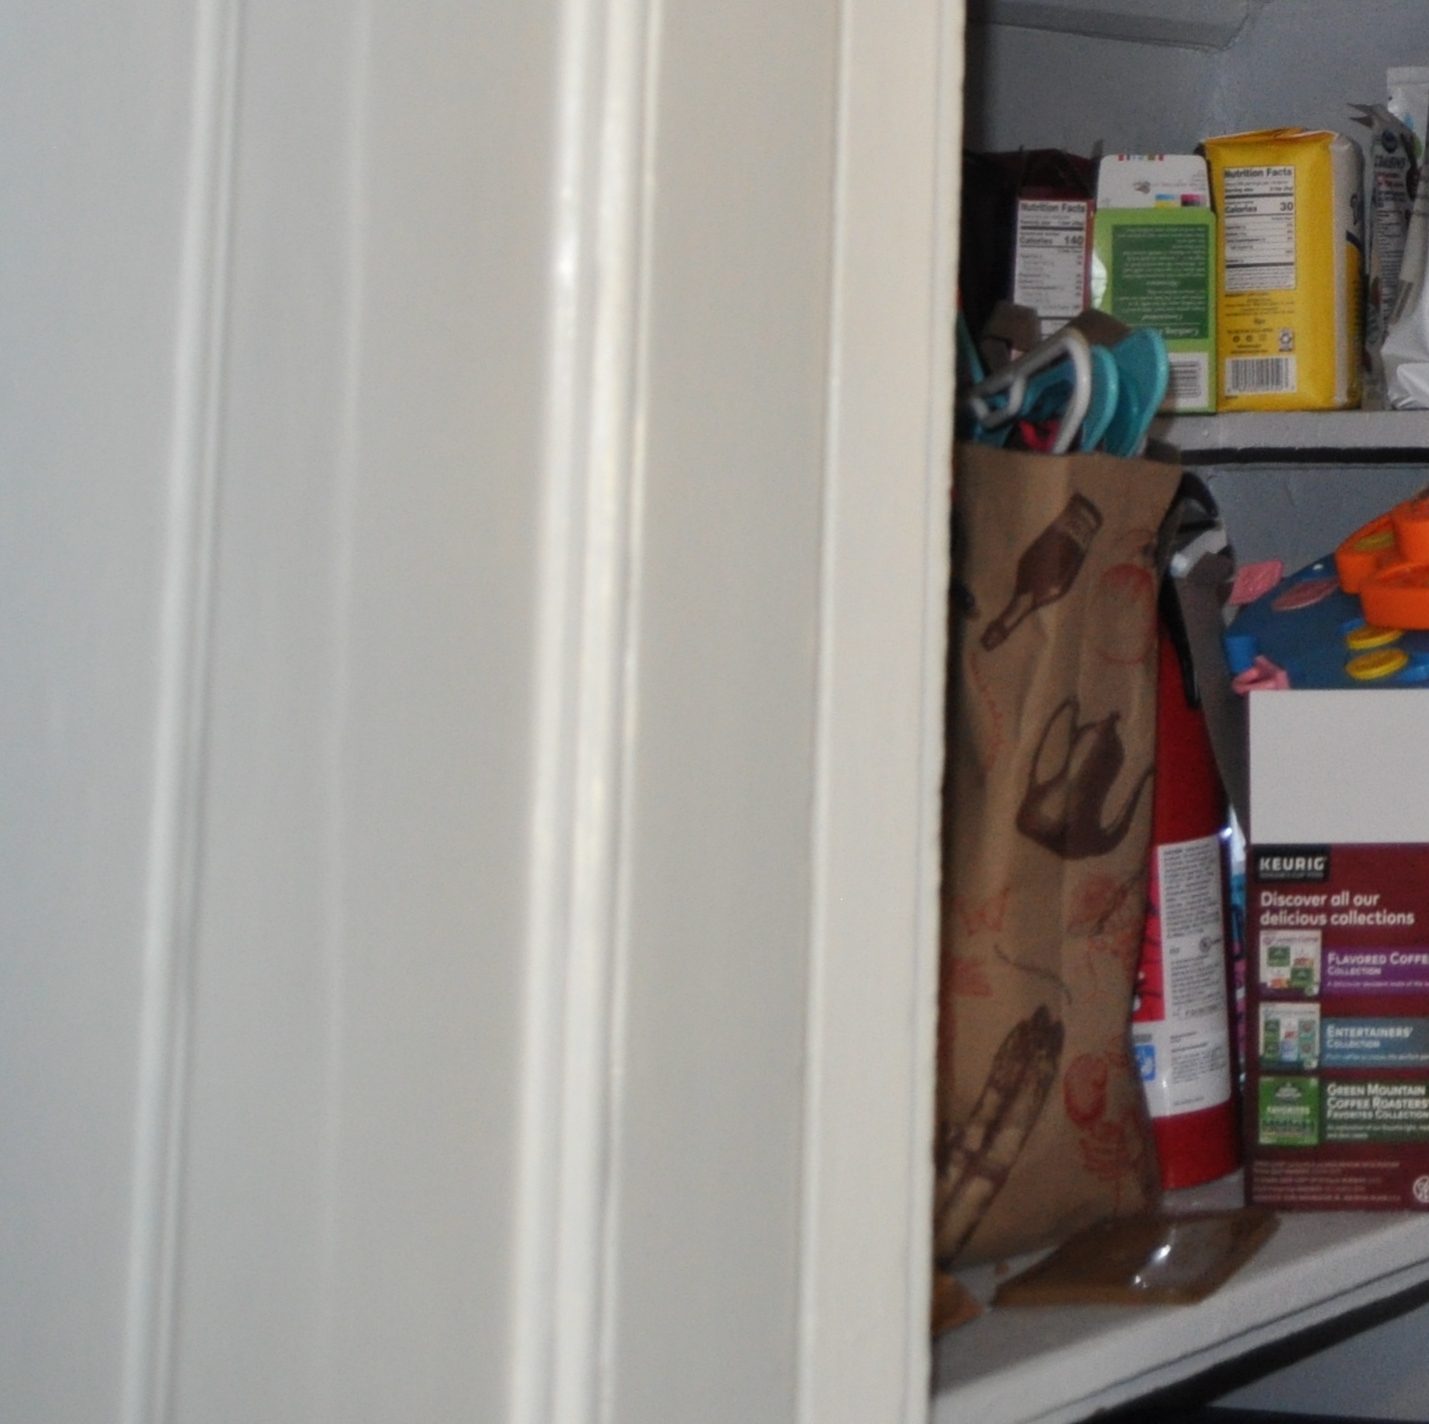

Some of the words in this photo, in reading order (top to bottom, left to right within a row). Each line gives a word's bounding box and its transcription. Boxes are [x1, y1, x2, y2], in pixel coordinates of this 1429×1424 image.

[1224, 169, 1264, 178] Nutrition
[1266, 167, 1292, 177] Facts
[1020, 202, 1059, 213] Nutrition
[1060, 202, 1086, 213] Facts
[1225, 204, 1258, 214] Calories
[1279, 201, 1294, 212] 30
[1019, 236, 1053, 245] Calories
[1064, 235, 1084, 246] 140
[1258, 856, 1328, 874] KEURIG
[1260, 890, 1329, 908] Discover
[1330, 890, 1351, 907] all
[1352, 893, 1381, 907] our
[1260, 909, 1328, 927] delicious
[1329, 908, 1416, 926] collections
[1327, 952, 1387, 966] FLAVORED
[1327, 966, 1383, 977] COLLECTION
[1326, 1040, 1381, 1052] COLLECTION
[1327, 1083, 1365, 1097] GREEN
[1366, 1084, 1427, 1096] MOUNTAIN
[1327, 1097, 1370, 1111] COFFEE
[1374, 1111, 1429, 1123] COLLECTION
